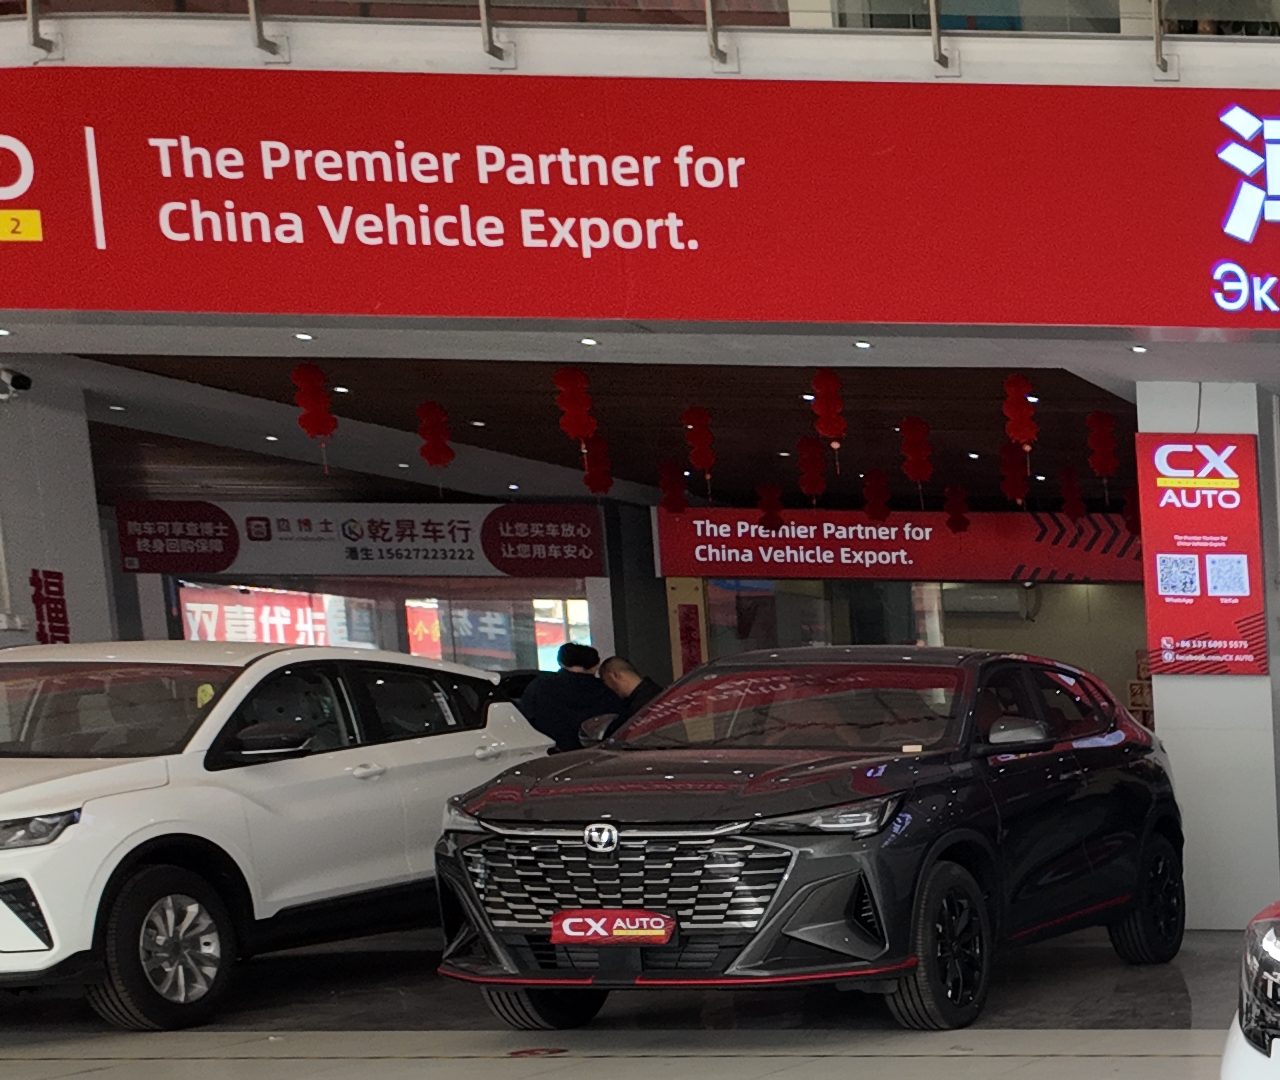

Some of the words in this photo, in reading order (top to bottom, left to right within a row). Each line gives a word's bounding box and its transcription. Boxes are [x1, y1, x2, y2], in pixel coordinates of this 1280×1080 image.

[149, 136, 244, 179] The
[261, 140, 460, 184] Premier
[477, 145, 660, 188] Partner
[675, 145, 746, 188] for
[159, 200, 304, 244] China
[319, 204, 504, 248] Vehicle
[521, 209, 699, 258] Export.
[1154, 444, 1238, 478] CX
[1159, 489, 1240, 508] AUTO
[499, 522, 591, 538] 让您买车放心
[693, 520, 731, 538] The
[823, 523, 898, 541] Partner
[903, 522, 932, 541] for
[501, 543, 594, 560] 让您用车安心
[695, 544, 753, 563] China
[758, 545, 834, 564] Vehicle
[840, 546, 914, 567] Export.
[562, 917, 609, 936] CX
[612, 917, 665, 930] AUTO
